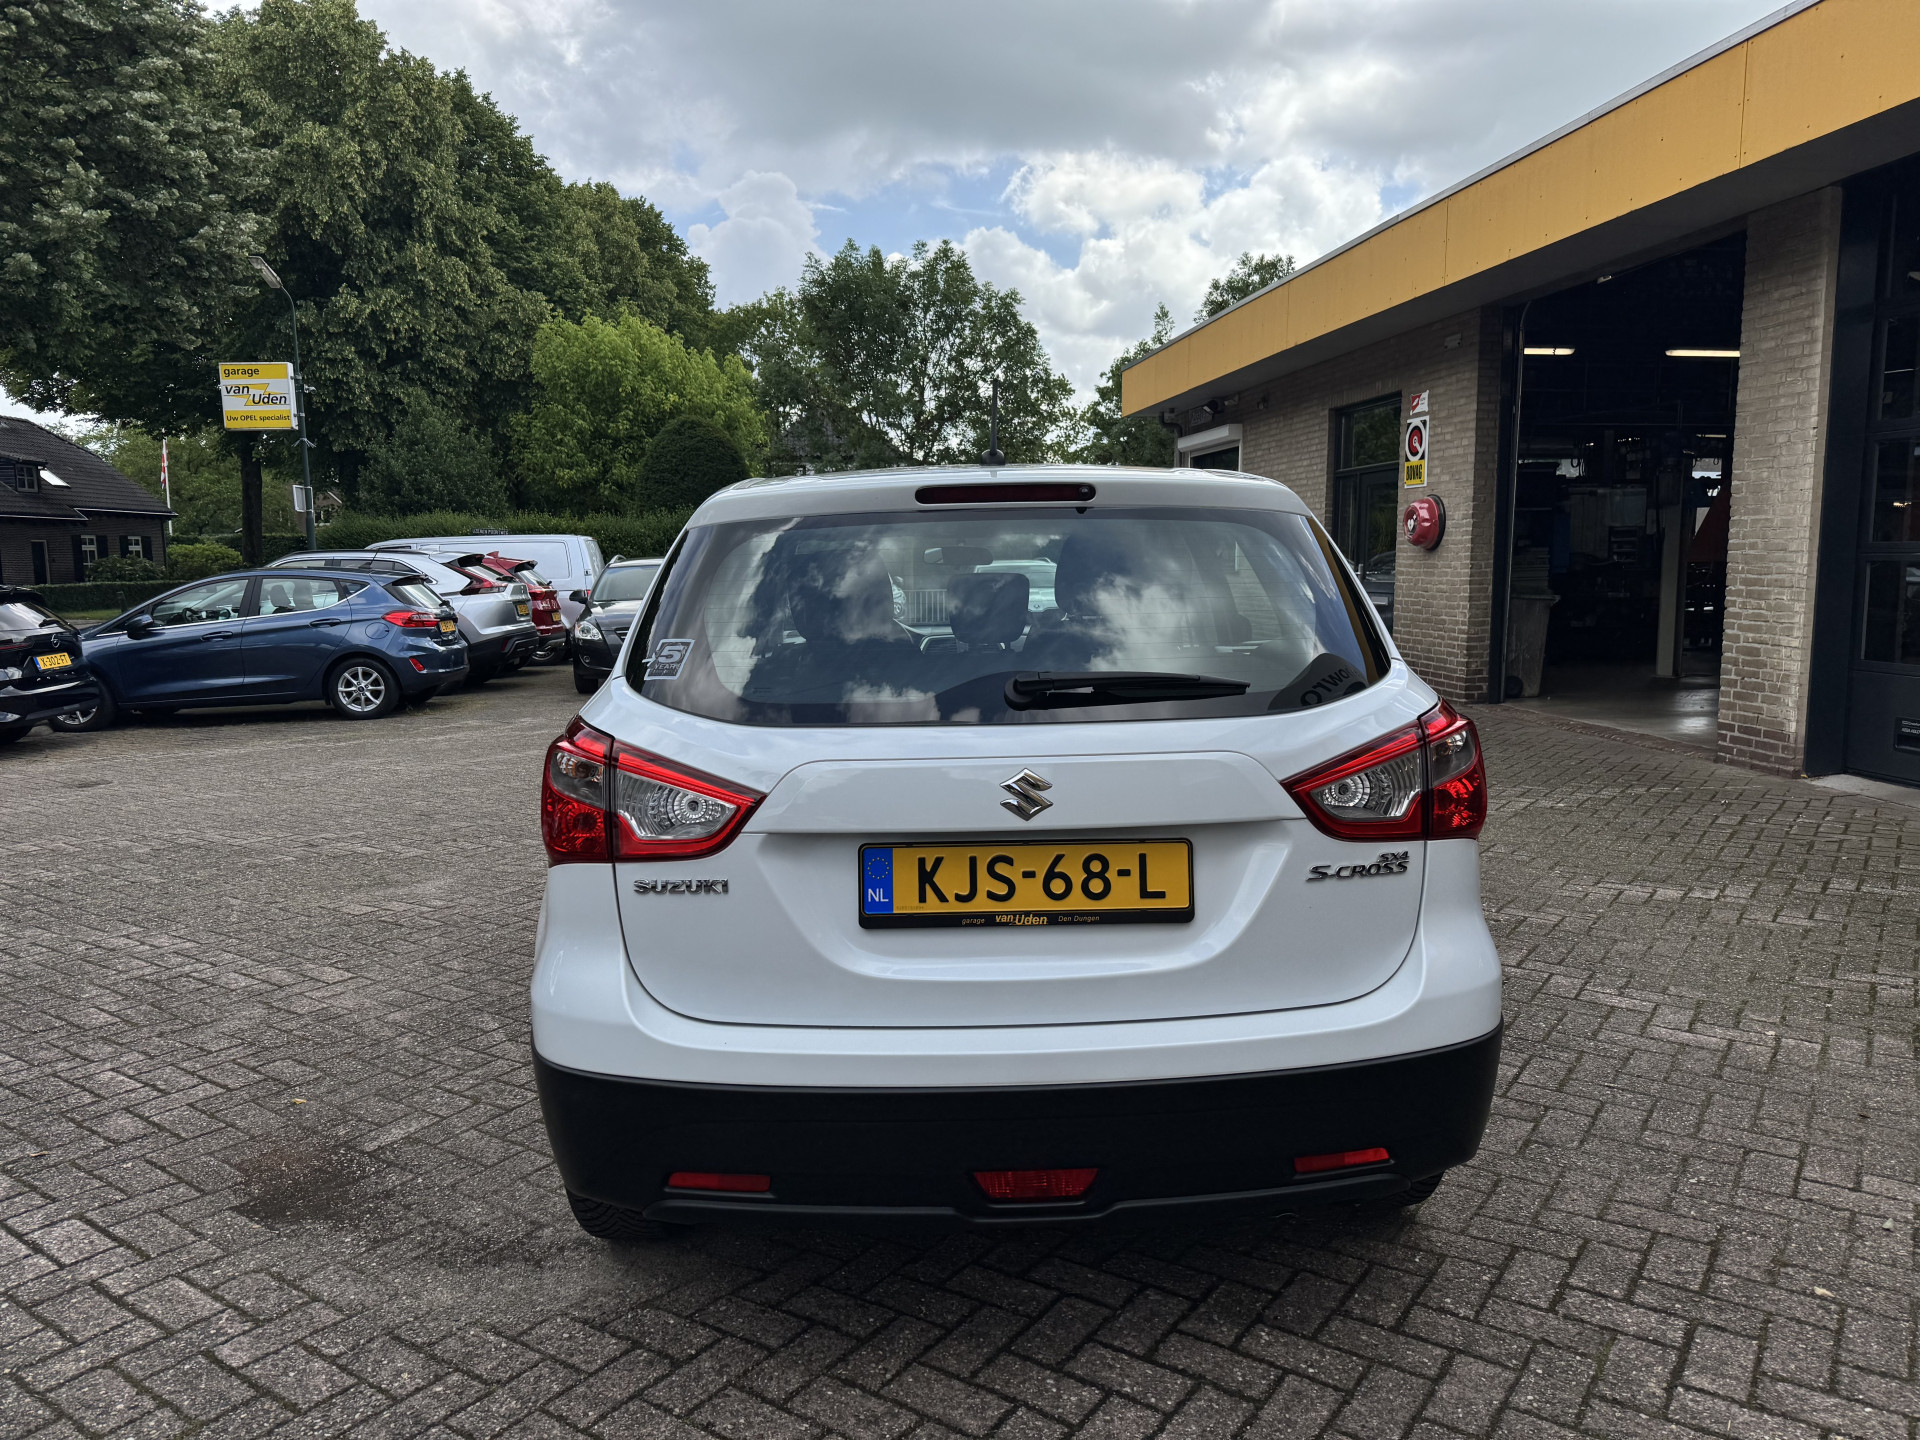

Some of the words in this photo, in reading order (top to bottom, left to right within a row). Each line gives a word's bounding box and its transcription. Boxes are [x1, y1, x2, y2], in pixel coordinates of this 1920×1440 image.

[223, 368, 260, 377] garage
[225, 385, 250, 394] van
[252, 393, 287, 405] Uden
[258, 414, 291, 422] specialist
[1406, 464, 1422, 481] BOVAG
[658, 645, 682, 663] 5
[40, 654, 69, 667] X-302-FT
[1379, 851, 1410, 863] SX4
[917, 852, 1166, 904] KJS-68-L
[633, 878, 729, 895] SUZUKI
[868, 888, 889, 902] NL
[995, 914, 1014, 923] van
[1015, 914, 1048, 926] Uden
[1073, 915, 1100, 923] Dungen
